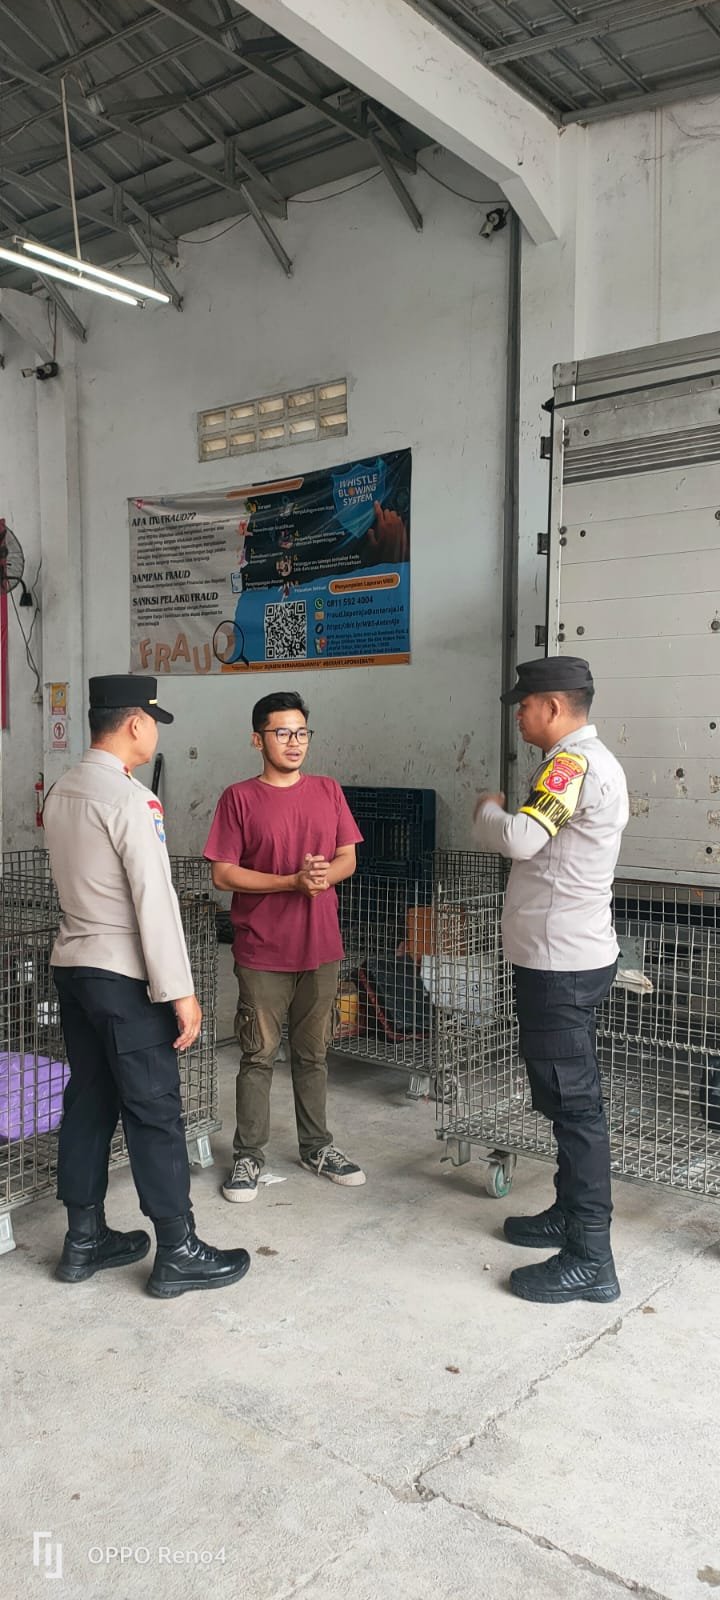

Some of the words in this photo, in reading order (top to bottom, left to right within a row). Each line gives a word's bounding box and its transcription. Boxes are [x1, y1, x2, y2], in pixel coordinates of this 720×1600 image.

[340, 473, 378, 488] WHISTLE
[343, 493, 373, 506] SYSTEM
[165, 569, 191, 581] FRAUD
[190, 591, 219, 603] FRAUD
[326, 599, 342, 608] 0811
[343, 597, 356, 606] 592
[358, 595, 374, 604] 4004
[140, 624, 236, 674] FRAUD
